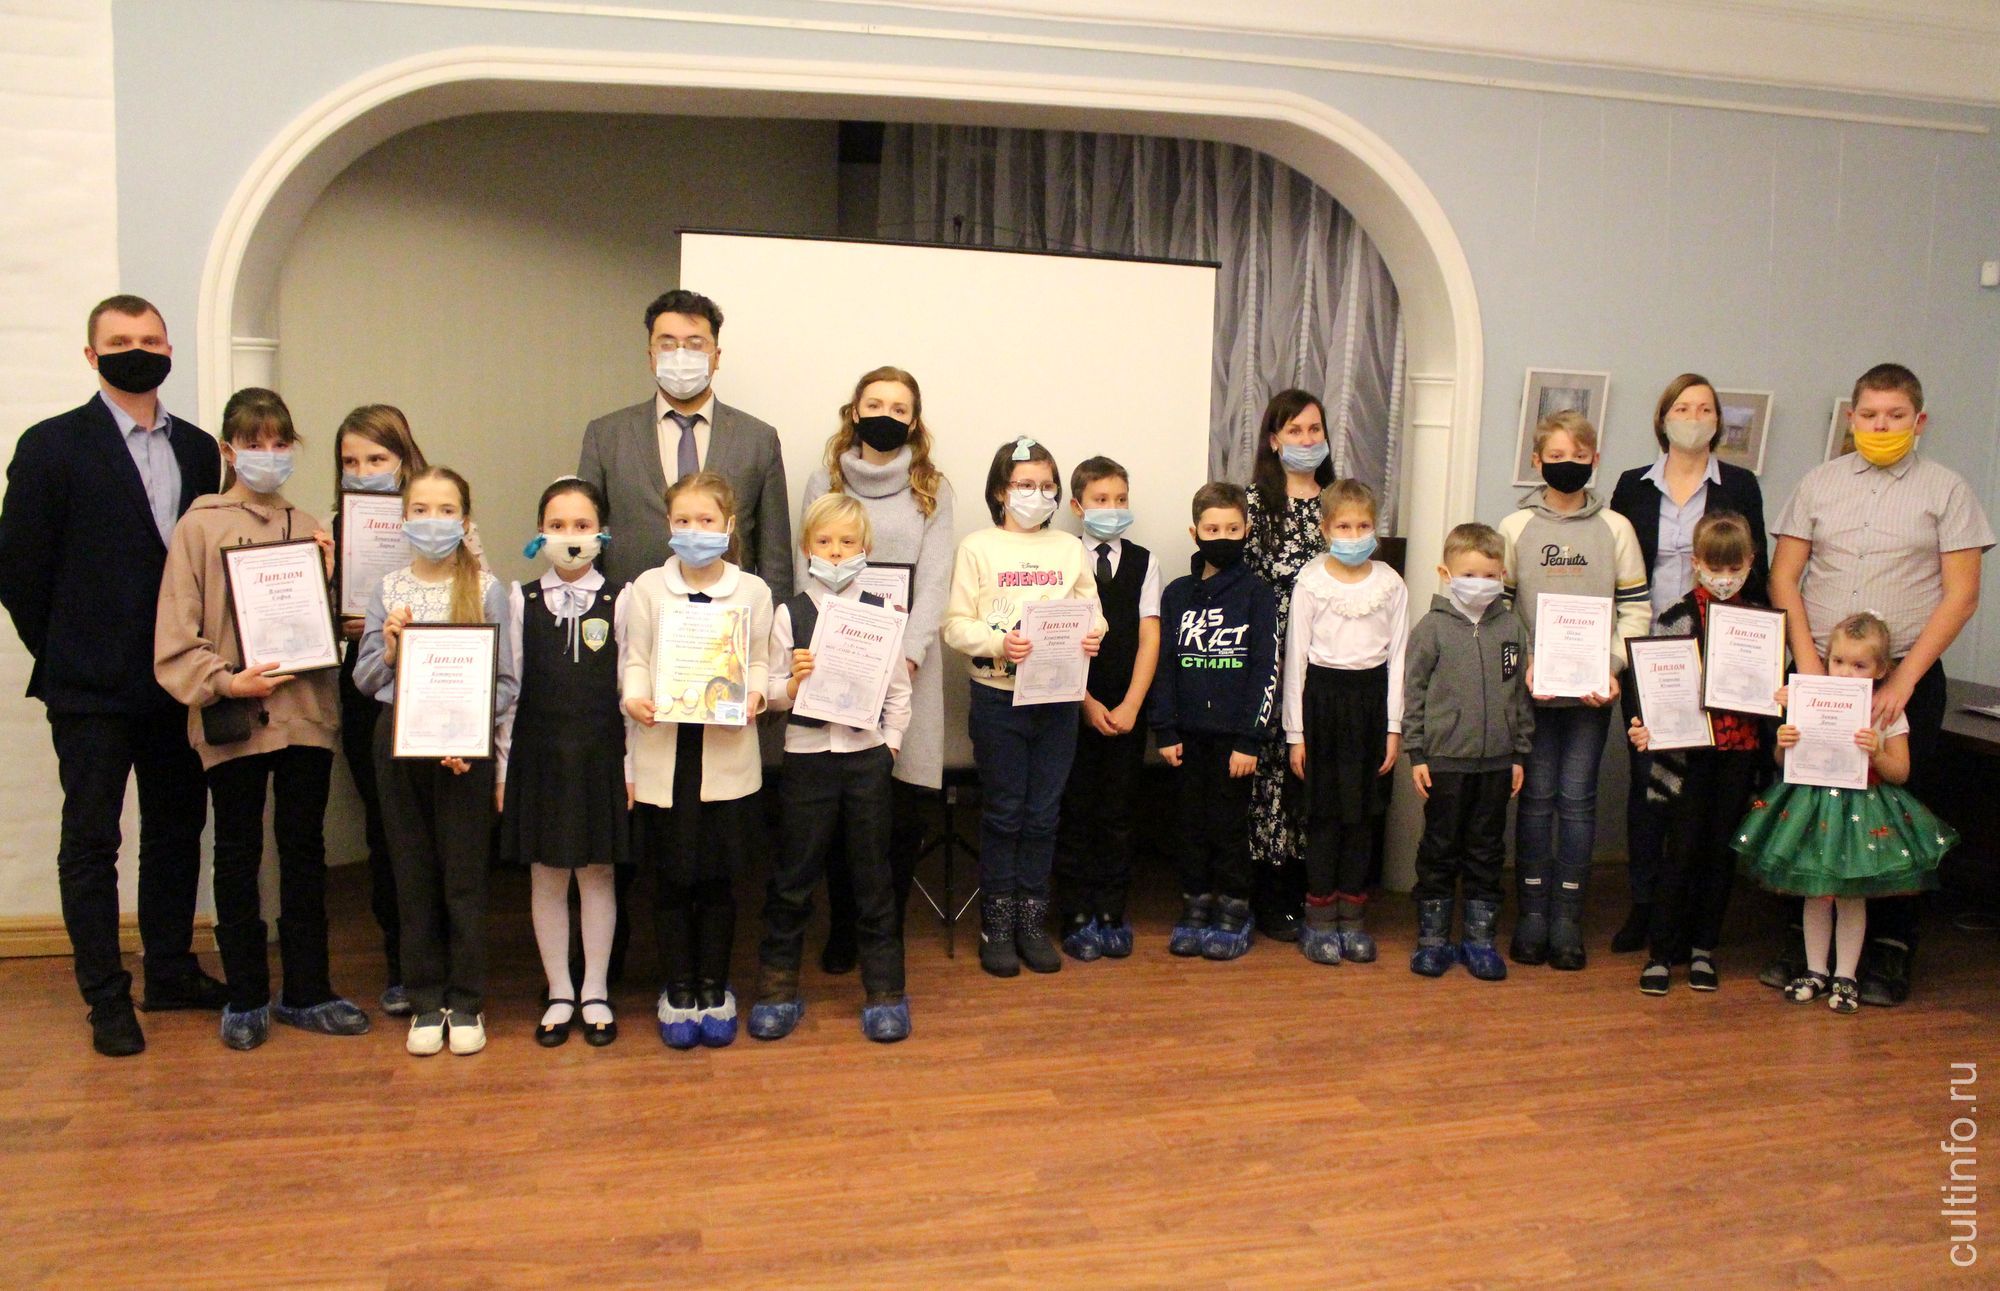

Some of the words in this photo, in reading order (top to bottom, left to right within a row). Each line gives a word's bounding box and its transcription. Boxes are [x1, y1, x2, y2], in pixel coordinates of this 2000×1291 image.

[363, 518, 402, 529] Дипло
[1540, 544, 1589, 566] Peanuts
[254, 570, 303, 584] Диплом
[998, 570, 1064, 587] FRIENDS!
[1038, 620, 1080, 631] Диплом
[1553, 615, 1595, 626] Диплом
[835, 622, 884, 643] Диплом
[1725, 625, 1767, 640] Диплом
[422, 653, 474, 665] Диплом
[1181, 656, 1244, 669] СТИЛЬ
[1650, 662, 1686, 673] Диплом
[1806, 697, 1854, 711] Диплом
